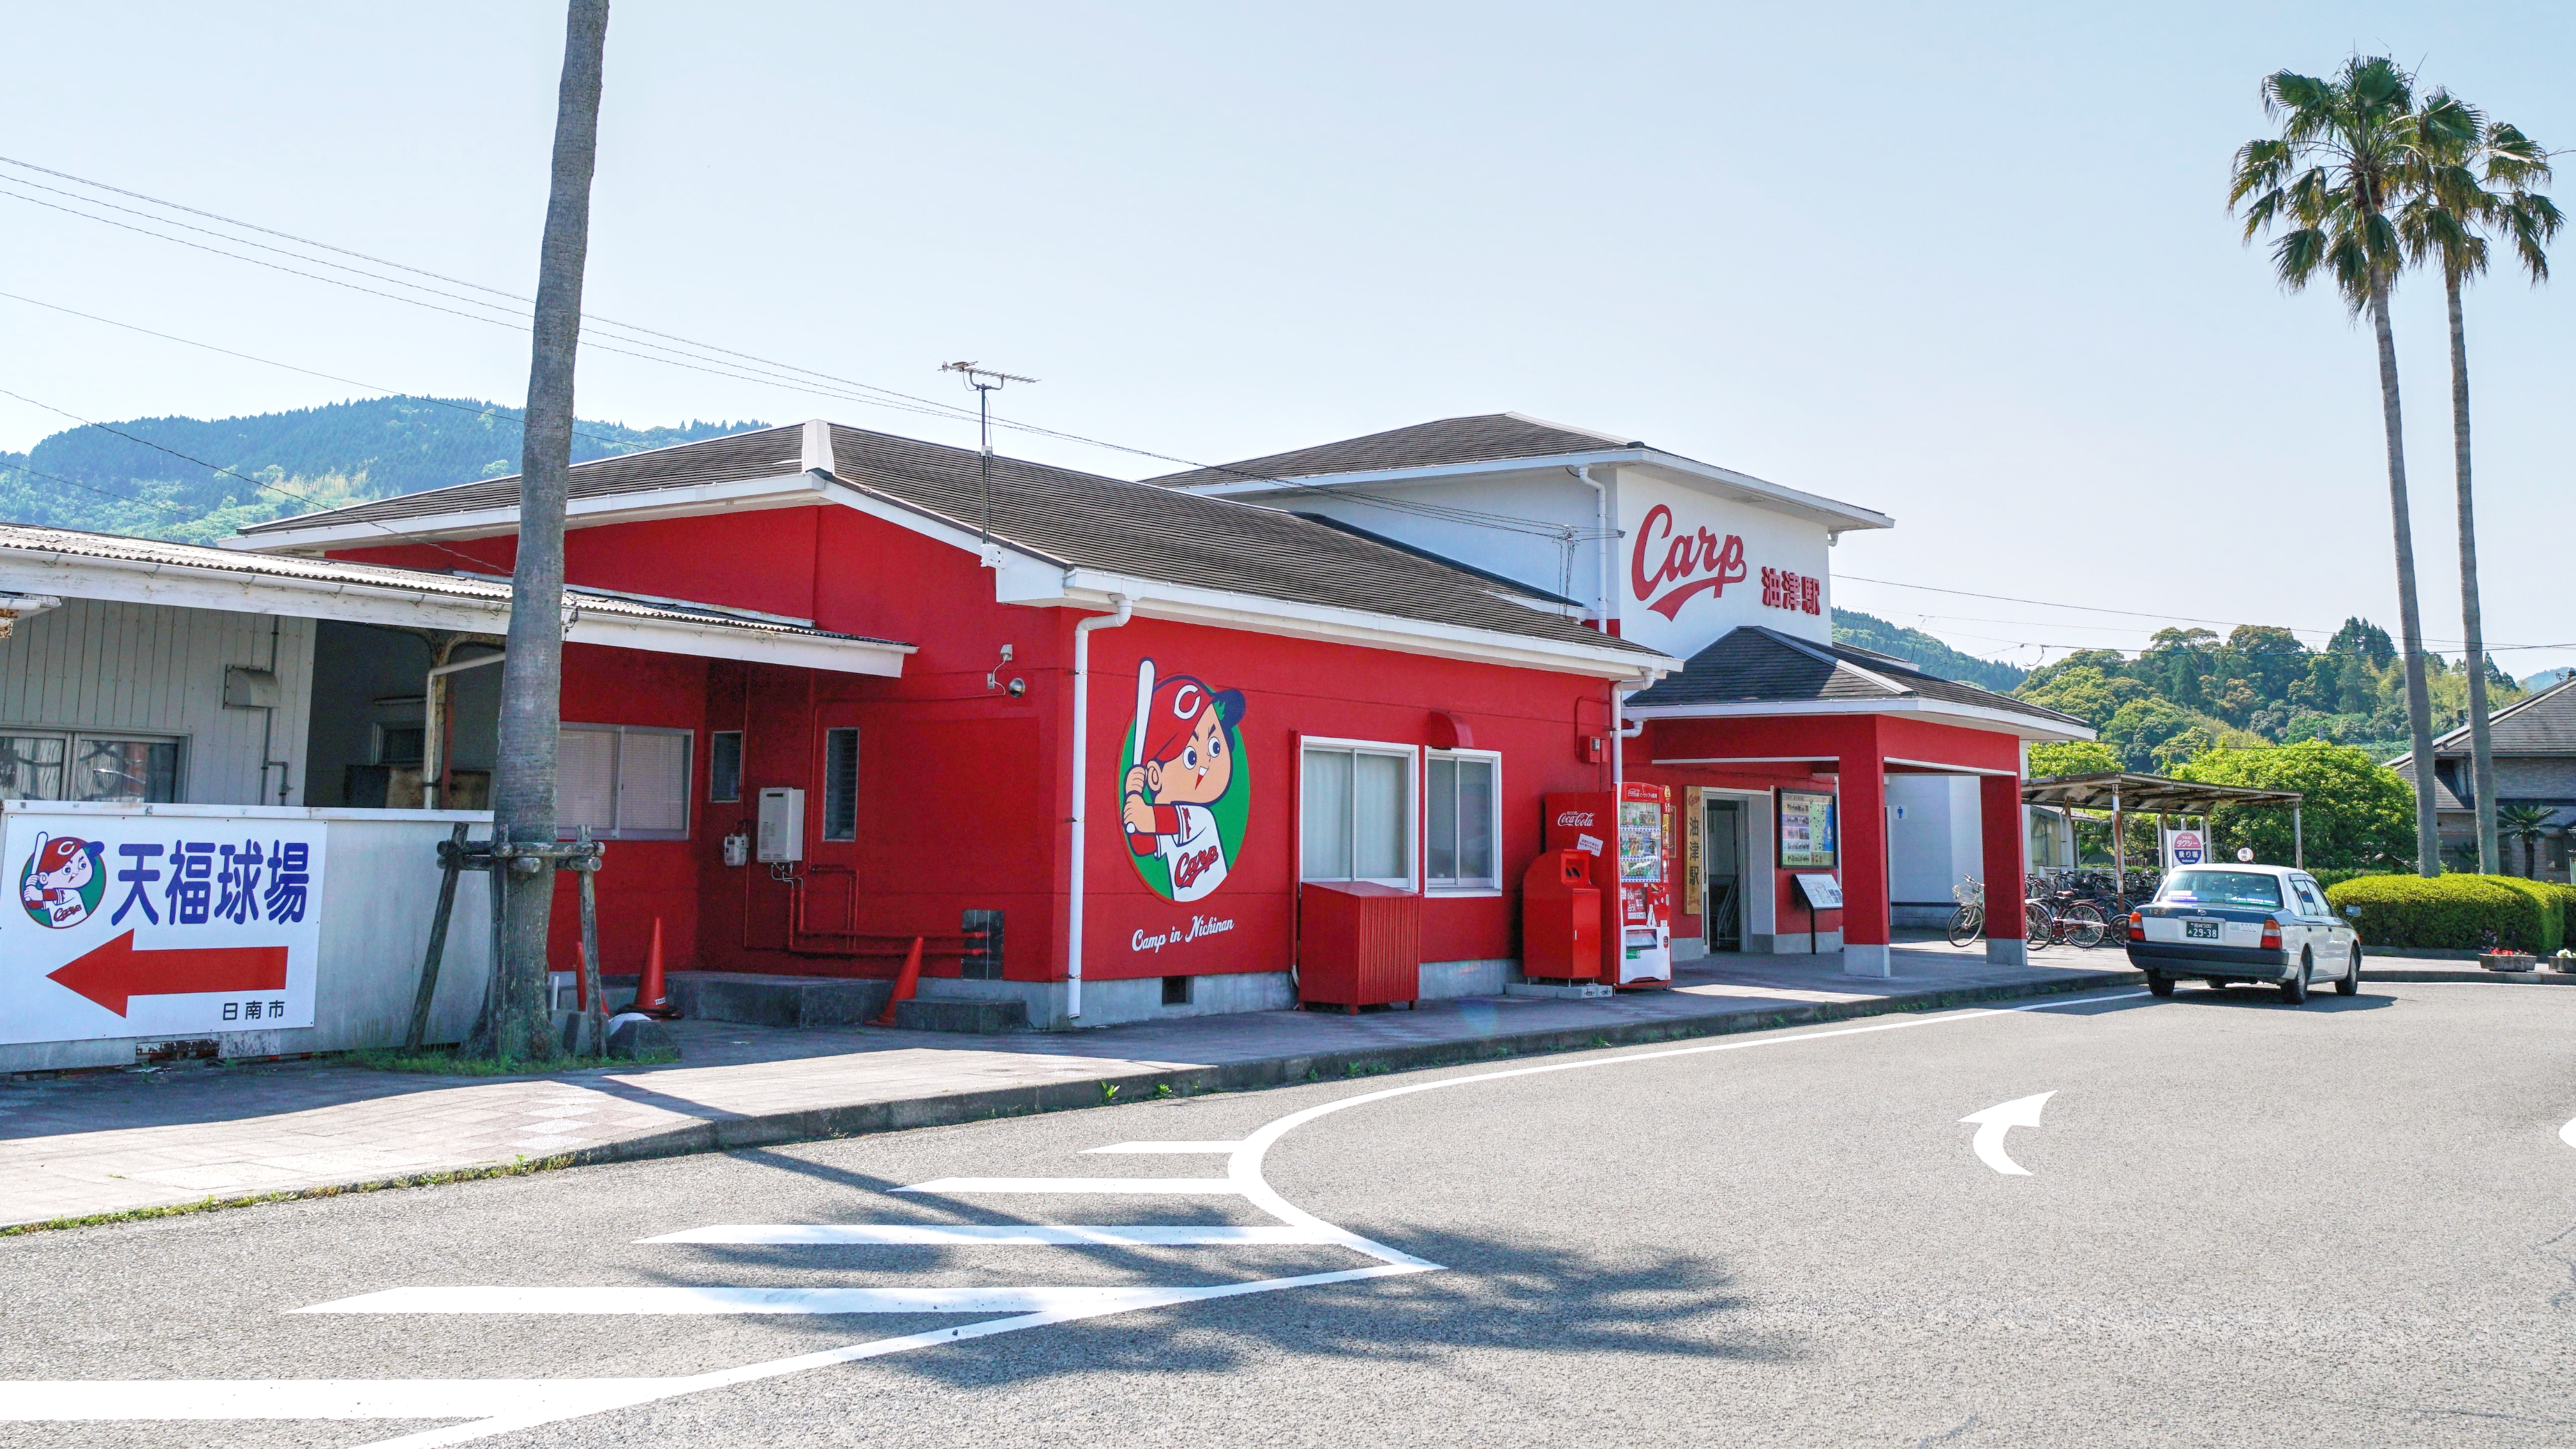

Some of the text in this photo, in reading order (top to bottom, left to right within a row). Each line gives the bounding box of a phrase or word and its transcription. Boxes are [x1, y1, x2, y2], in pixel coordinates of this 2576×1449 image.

[1631, 504, 1747, 622] Carp
[1761, 566, 1821, 616] 油津駅
[1557, 812, 1595, 827] Coca-Cola
[1174, 845, 1219, 891] Carp
[1689, 817, 1700, 886] 油津駅
[111, 838, 310, 926] 天福球場
[1132, 914, 1235, 953] Camp in Nichinan
[2193, 928, 2217, 938] 29-38
[222, 999, 285, 1021] 日南市
